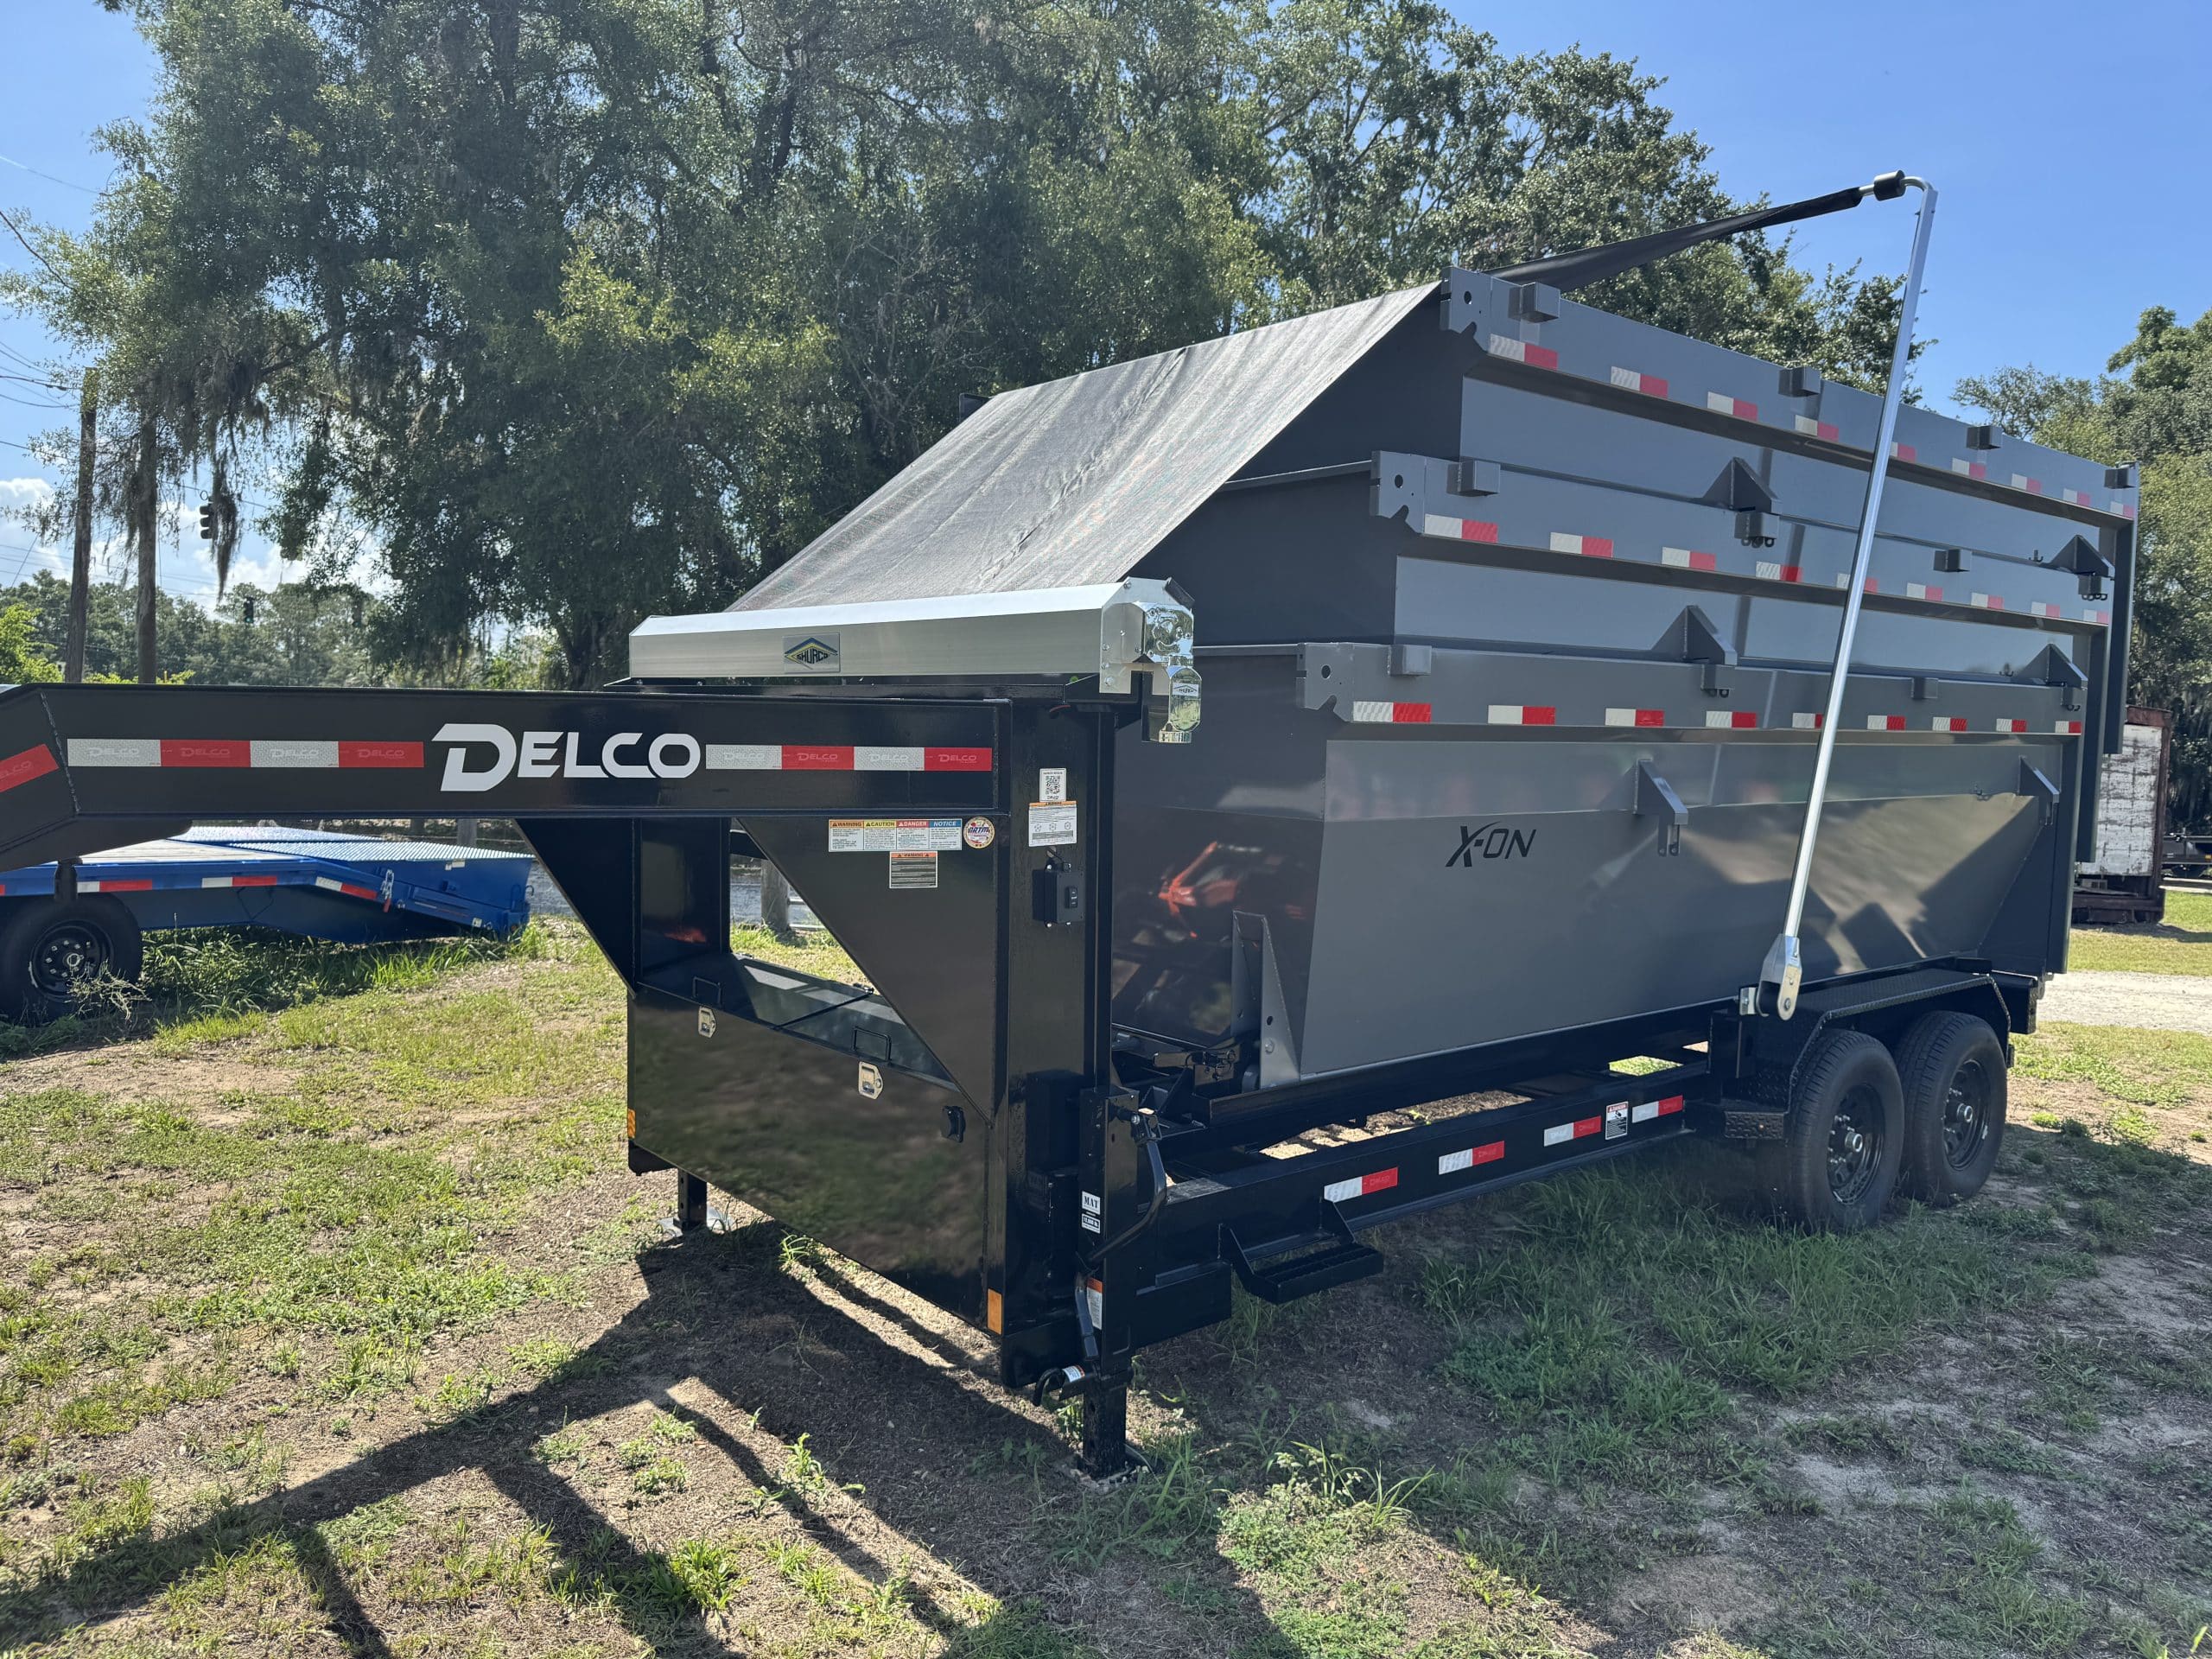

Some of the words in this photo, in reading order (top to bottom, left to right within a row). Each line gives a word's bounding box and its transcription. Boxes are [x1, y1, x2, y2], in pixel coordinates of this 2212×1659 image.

[796, 648, 830, 664] SHURCO
[431, 723, 701, 791] DELCO
[797, 753, 838, 761] DELCO
[938, 754, 977, 763] DELCO
[1083, 1195, 1098, 1209] MAT
